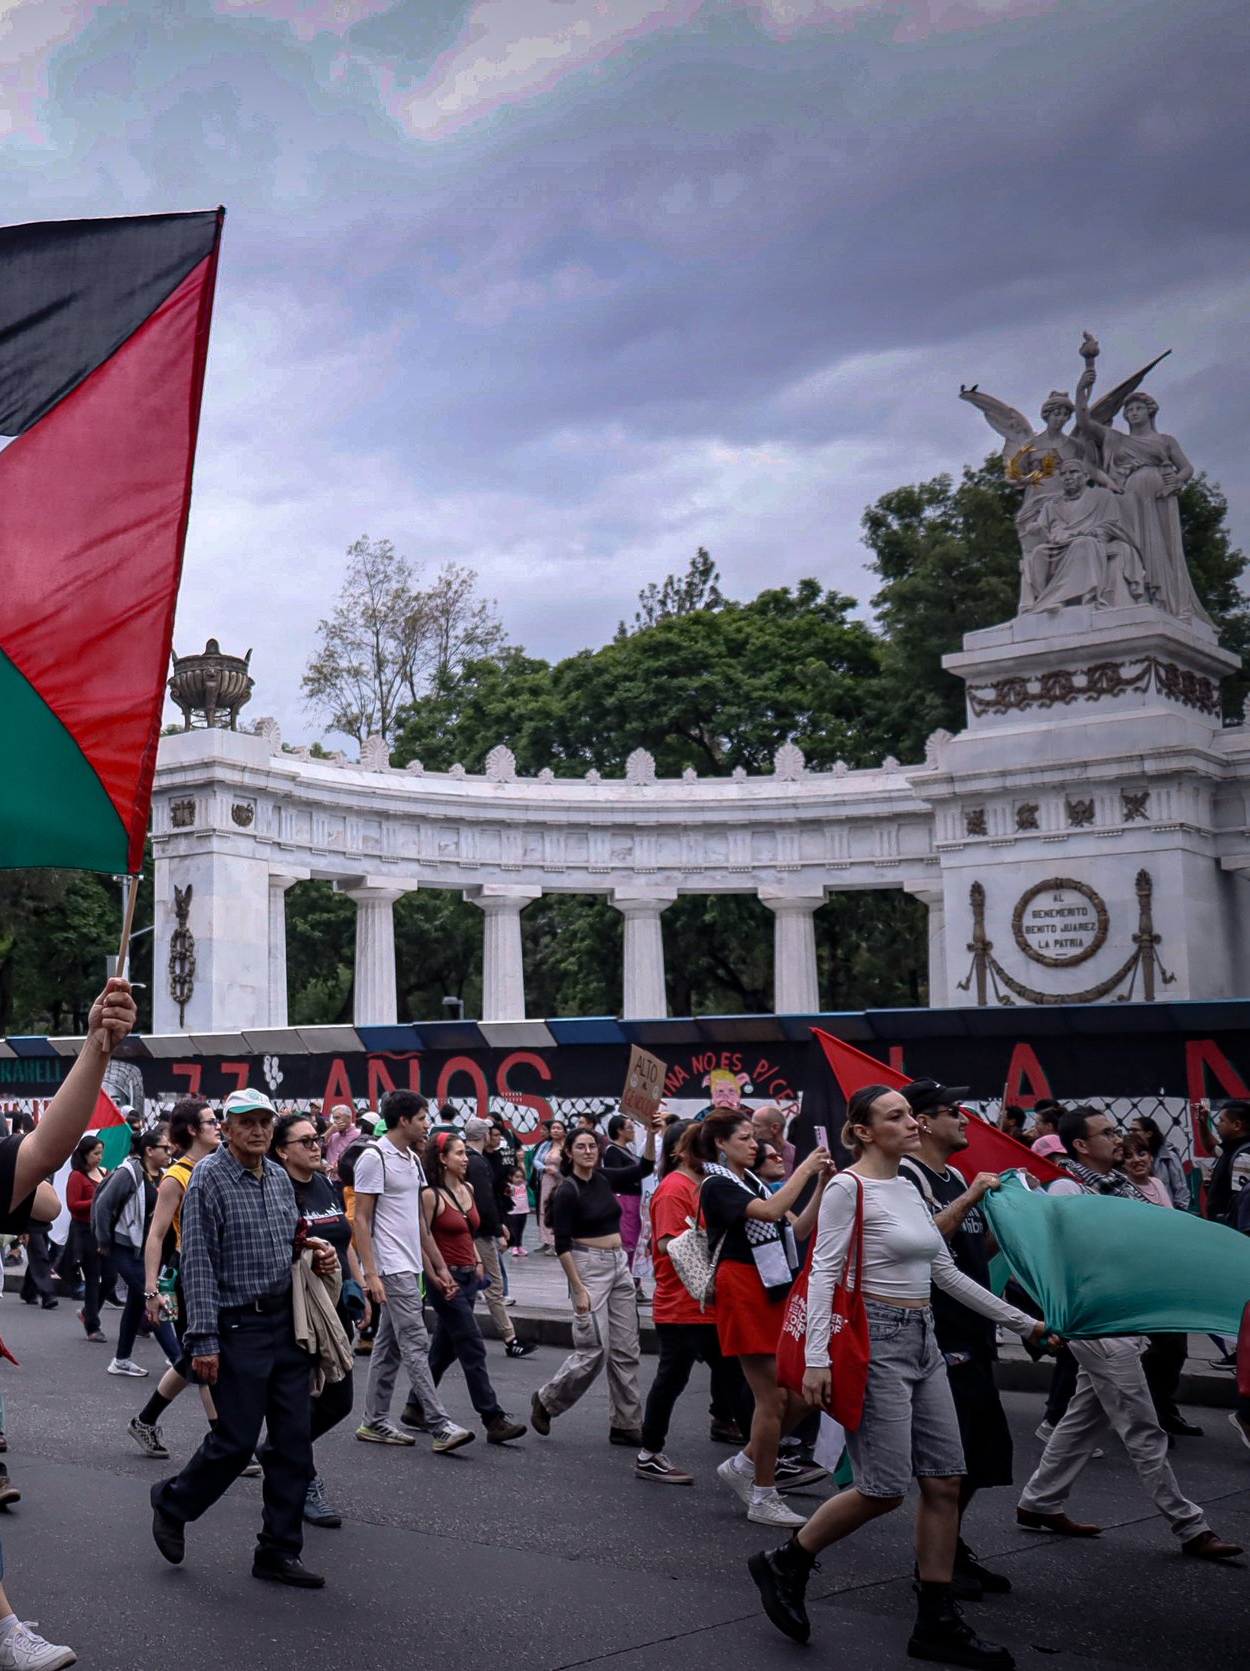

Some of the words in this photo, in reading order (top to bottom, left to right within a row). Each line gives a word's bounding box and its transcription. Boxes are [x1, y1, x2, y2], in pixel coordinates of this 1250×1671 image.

[1053, 893, 1064, 902] AL
[1032, 907, 1088, 919] BENEMERITO
[1025, 924, 1057, 934] BENITO
[1060, 922, 1096, 933] JUAREZ
[1038, 940, 1050, 949] LA
[1053, 938, 1084, 948] PATRIA
[634, 1055, 658, 1083] ALTO
[692, 1052, 716, 1075] NO
[721, 1051, 743, 1071] ES
[322, 1052, 552, 1145] AÑOS
